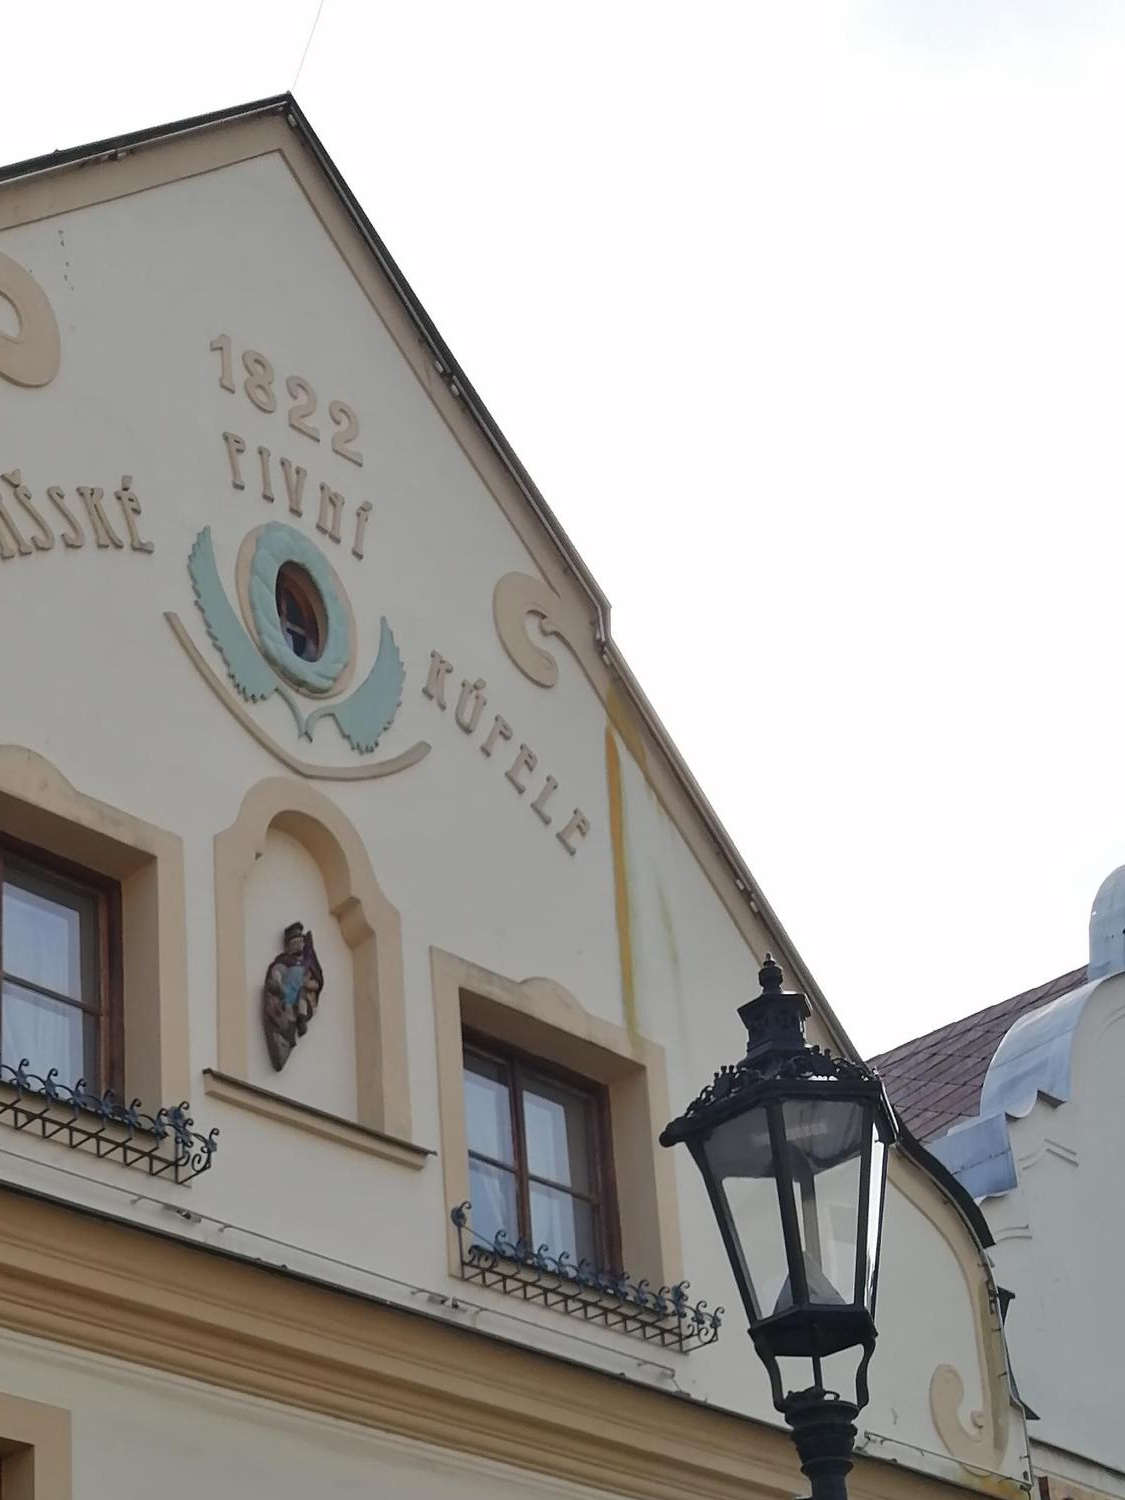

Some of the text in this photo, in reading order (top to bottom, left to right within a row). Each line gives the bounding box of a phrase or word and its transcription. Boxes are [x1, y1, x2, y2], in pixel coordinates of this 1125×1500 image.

[210, 334, 363, 467] 1822
[222, 432, 373, 560] PIVNÍ
[422, 650, 591, 857] KÚPELE
